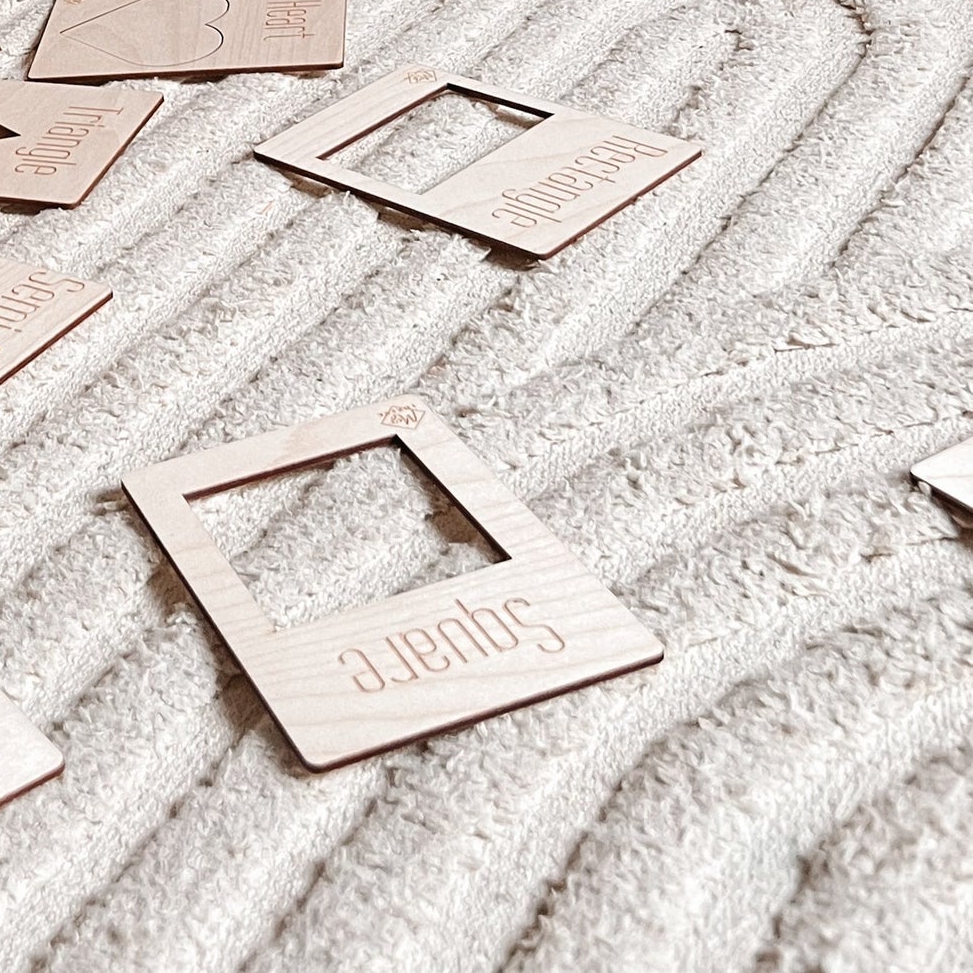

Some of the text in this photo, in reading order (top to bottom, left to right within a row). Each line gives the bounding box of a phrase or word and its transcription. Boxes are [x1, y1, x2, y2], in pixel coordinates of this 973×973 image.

[14, 105, 125, 176] Triangle
[491, 134, 669, 228] Rectangle
[337, 597, 566, 694] Square
